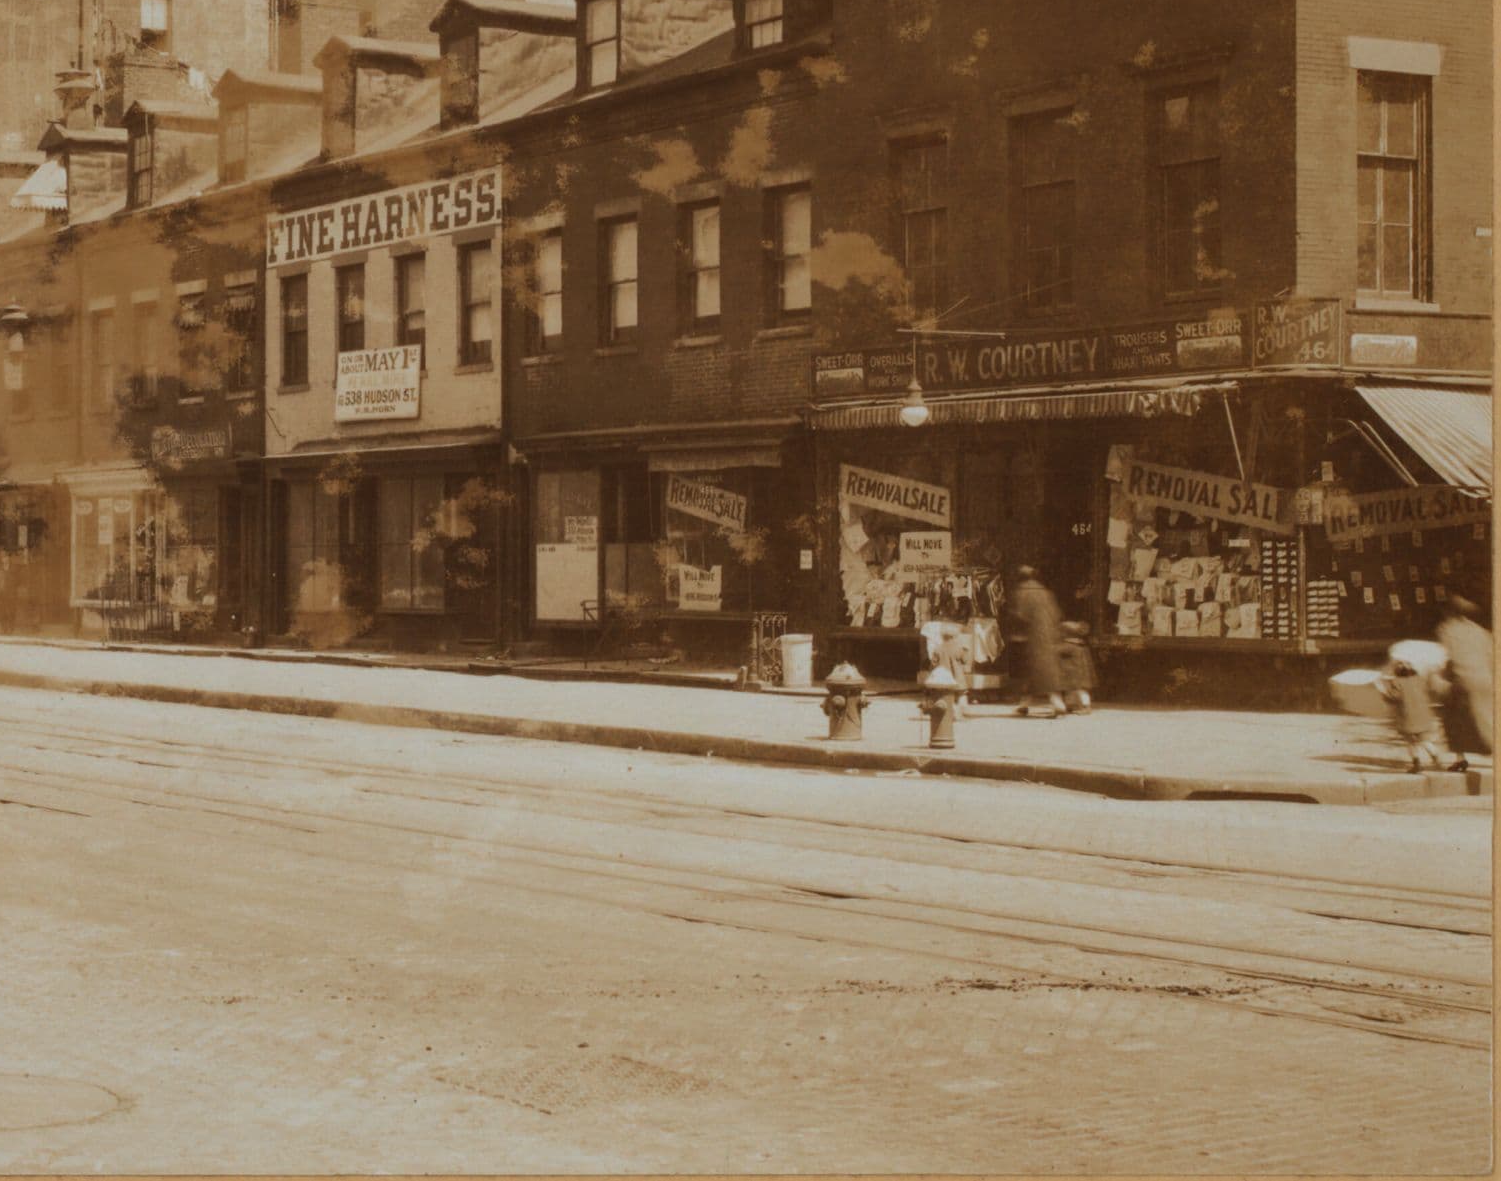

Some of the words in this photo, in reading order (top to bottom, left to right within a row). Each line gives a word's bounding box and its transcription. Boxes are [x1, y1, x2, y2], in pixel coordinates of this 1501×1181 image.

[267, 209, 335, 264] FINE
[1113, 330, 1168, 347] TROUSERS
[1256, 302, 1337, 359] COURTNEY
[365, 351, 399, 372] MAY
[869, 352, 913, 368] OVERALLS
[925, 355, 943, 383] R.
[948, 352, 969, 382] W.
[978, 337, 1099, 380] COURTNEY
[1141, 352, 1172, 366] PANTS
[364, 388, 401, 404] HUDSON
[846, 472, 910, 508] REMOVAL
[911, 487, 946, 516] SALE
[1129, 465, 1221, 509] REMOVAL
[1228, 483, 1286, 523] SAL
[904, 538, 922, 550] WILL
[923, 539, 942, 550] MOVE
